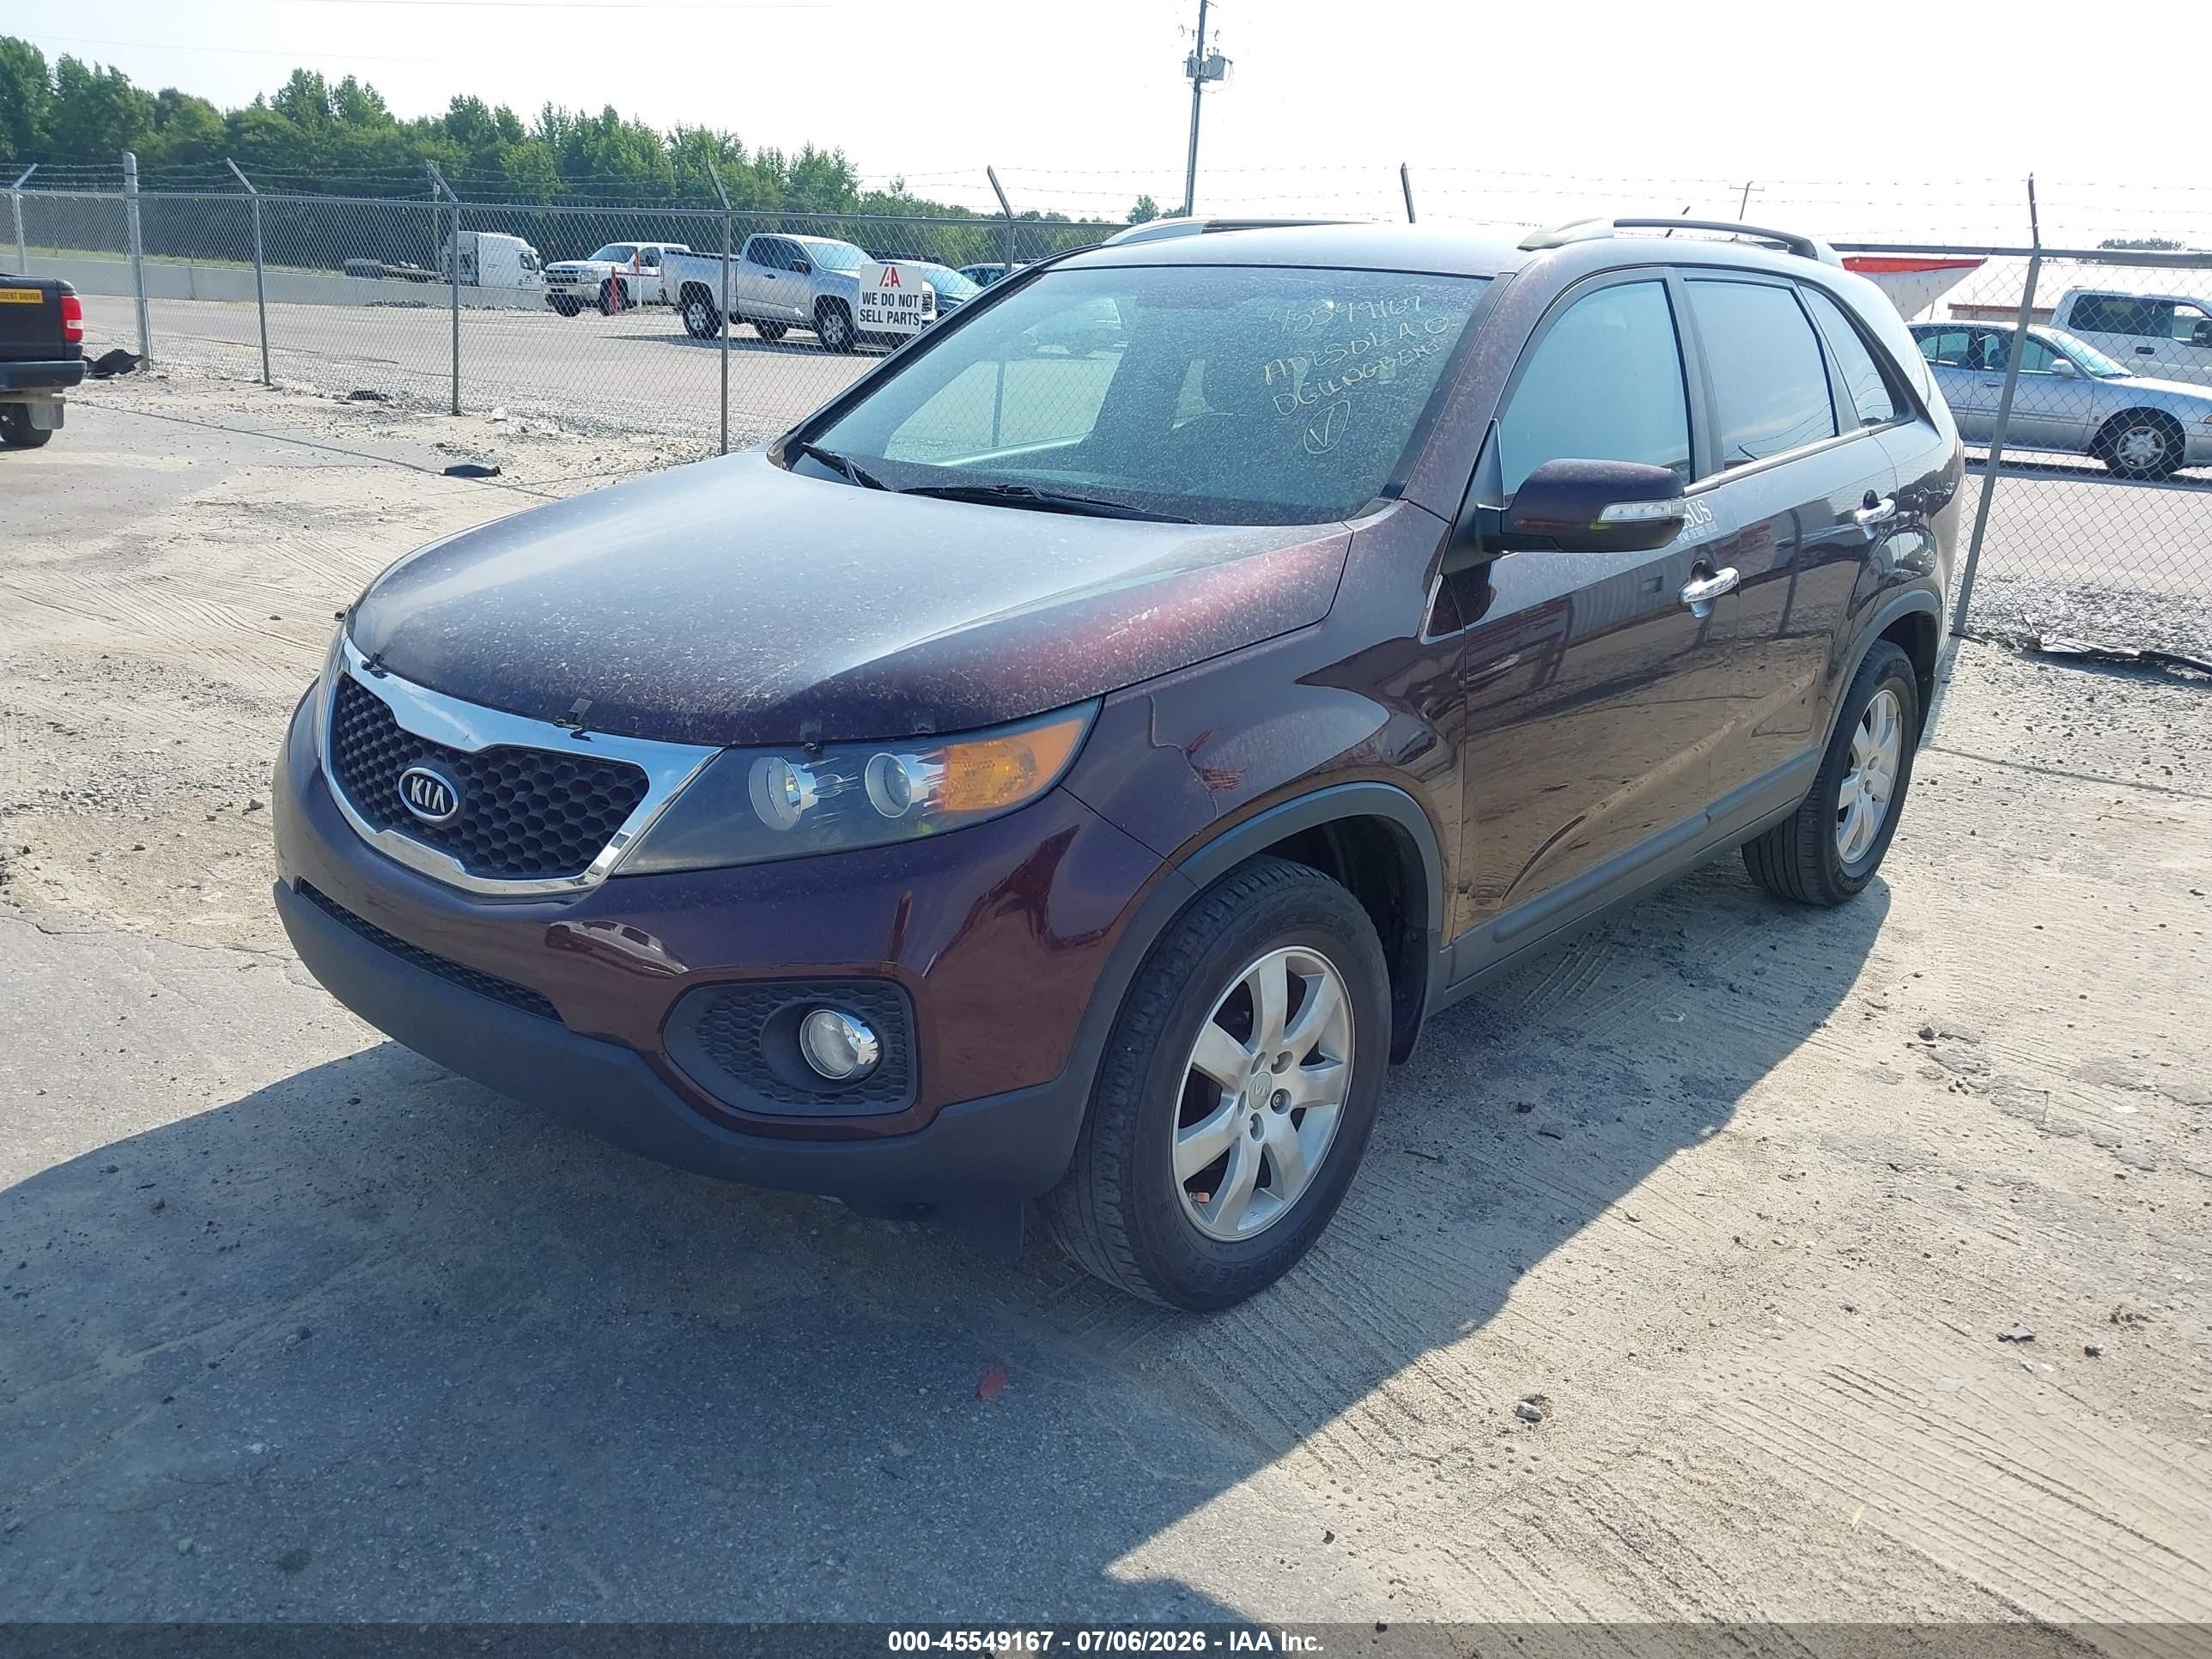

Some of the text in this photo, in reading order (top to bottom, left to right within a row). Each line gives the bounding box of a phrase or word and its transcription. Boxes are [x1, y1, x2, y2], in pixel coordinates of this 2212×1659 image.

[862, 292, 919, 308] WE DO NOT
[860, 309, 920, 326] SELL PARTS
[410, 775, 446, 813] KIA
